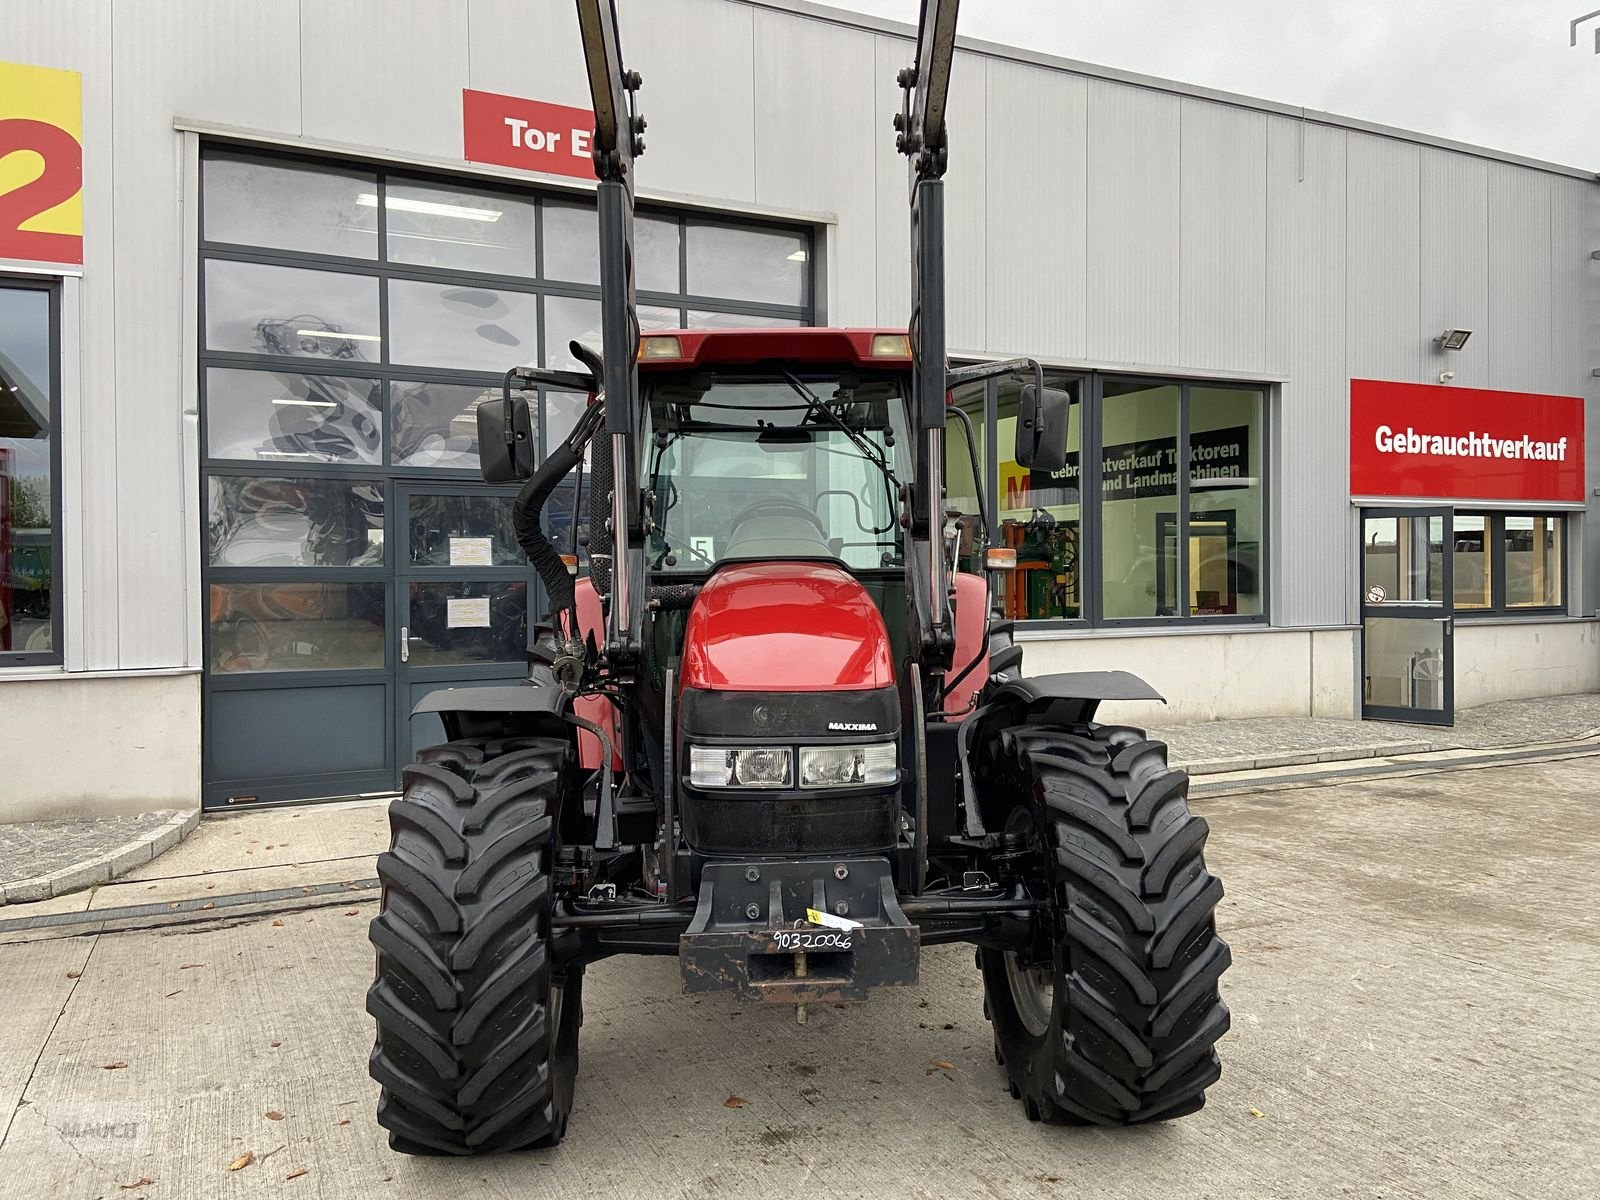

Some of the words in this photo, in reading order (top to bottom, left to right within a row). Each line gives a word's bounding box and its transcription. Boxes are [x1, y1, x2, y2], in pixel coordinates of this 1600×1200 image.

[504, 117, 560, 152] Tor
[571, 128, 597, 158] E
[1375, 425, 1567, 461] Gebrauchtverkauf
[1050, 450, 1162, 480] Gebrtverkauf
[1168, 442, 1240, 465] Tktoren
[1126, 464, 1240, 489] Landmachinen
[828, 722, 878, 731] MAXXIMA
[773, 931, 852, 950] 90320066
